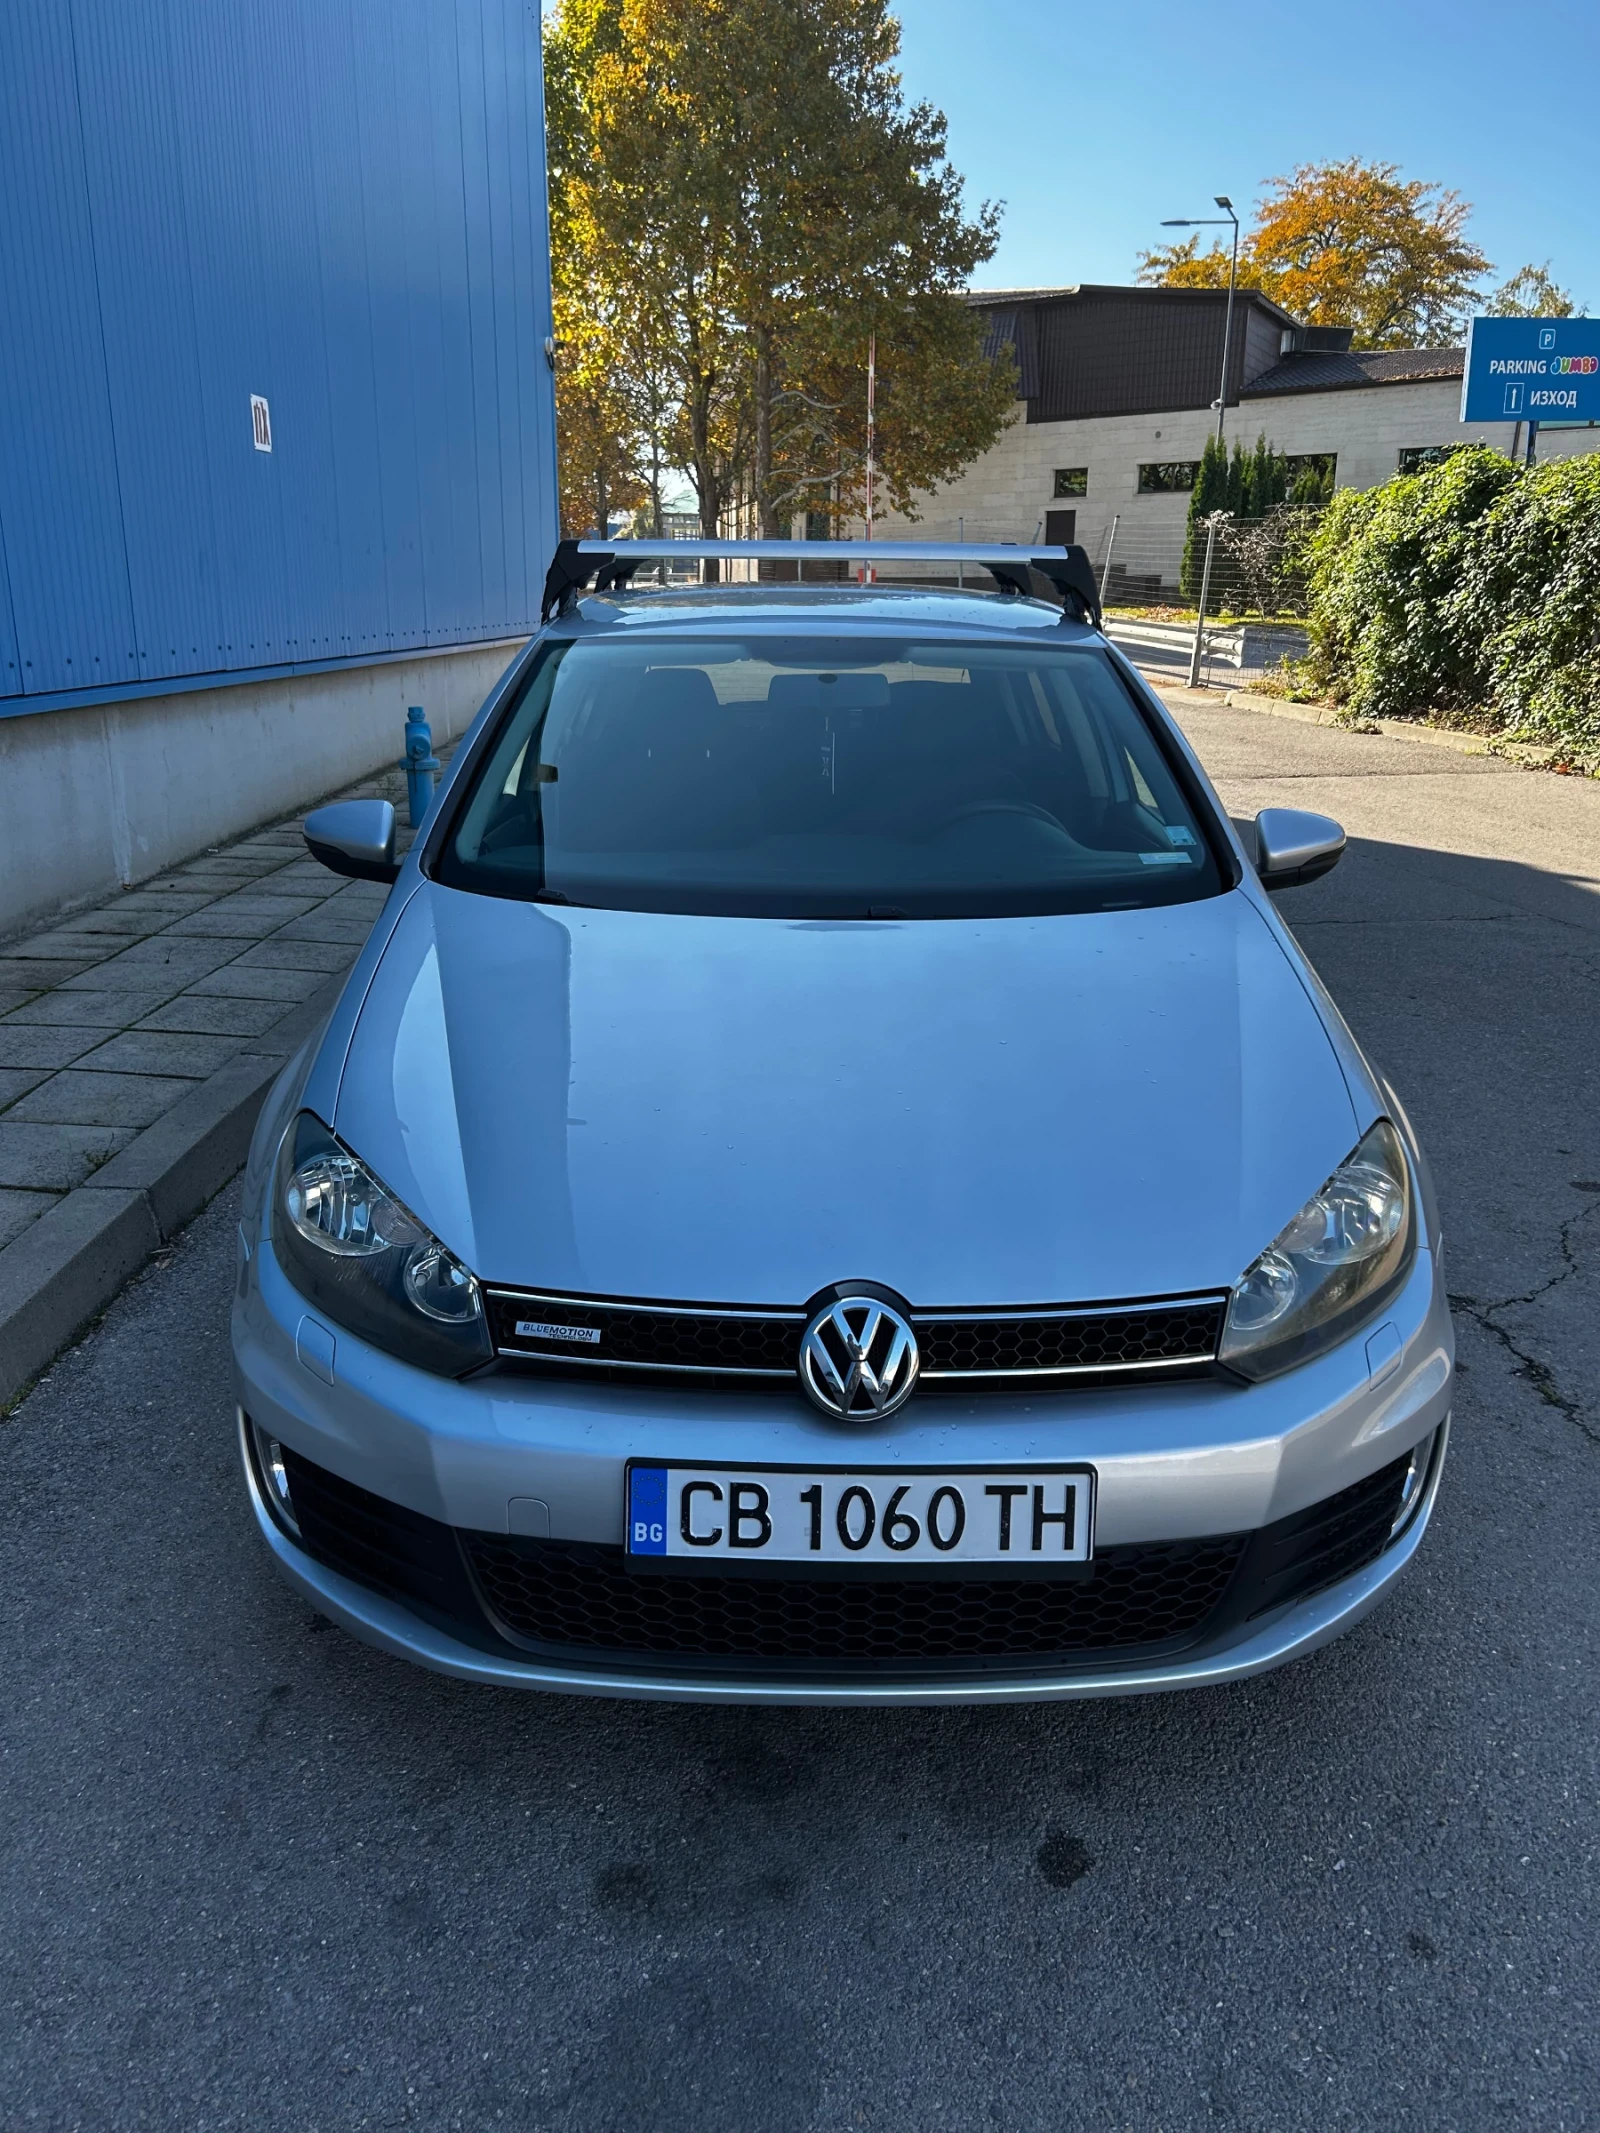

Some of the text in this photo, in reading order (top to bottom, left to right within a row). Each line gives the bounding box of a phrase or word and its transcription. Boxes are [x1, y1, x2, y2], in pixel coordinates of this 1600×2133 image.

[1544, 334, 1552, 346] P
[1489, 356, 1598, 375] PARKING JUMBO
[1530, 391, 1578, 408] ИЗХОД
[523, 1323, 594, 1338] BLUEMOTION
[801, 1299, 917, 1416] VW
[680, 1480, 1076, 1551] CB 1060 TH
[634, 1522, 663, 1543] BG
